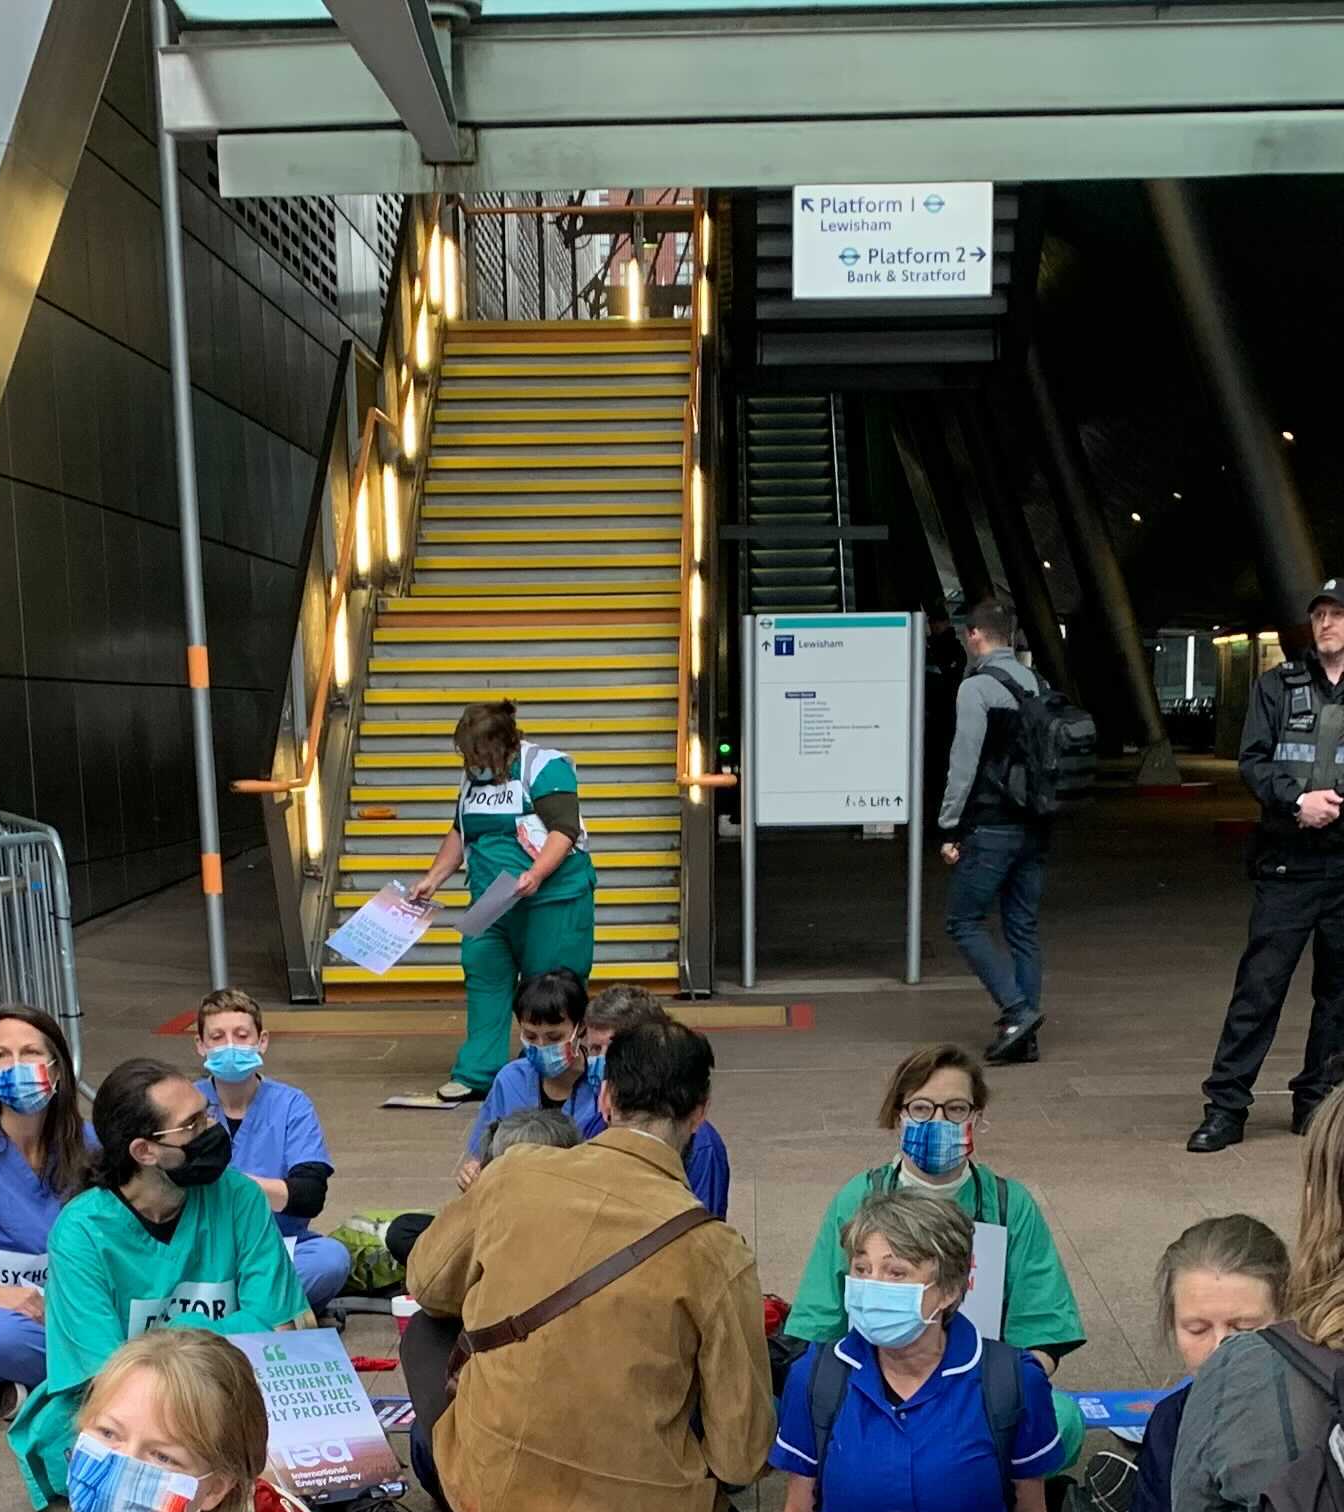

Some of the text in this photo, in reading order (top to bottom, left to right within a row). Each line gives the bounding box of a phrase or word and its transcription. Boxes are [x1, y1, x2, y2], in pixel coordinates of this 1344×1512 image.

[820, 197, 915, 213] Platform 1
[820, 219, 892, 232] Lewisham
[868, 247, 966, 265] Platform 2
[847, 269, 966, 283] Bank & Stratford
[798, 639, 844, 649] Lewisham
[870, 796, 891, 807] Lift
[145, 1298, 226, 1333] TOR
[267, 1363, 321, 1379] SHOULD
[325, 1360, 341, 1373] BE
[263, 1373, 353, 1393] VESTMENT IN
[272, 1388, 352, 1407] FOSSIL FUEL
[267, 1400, 360, 1422] PLY PROJECTS
[292, 1466, 349, 1479] International
[295, 1473, 361, 1488] Energy Agency
